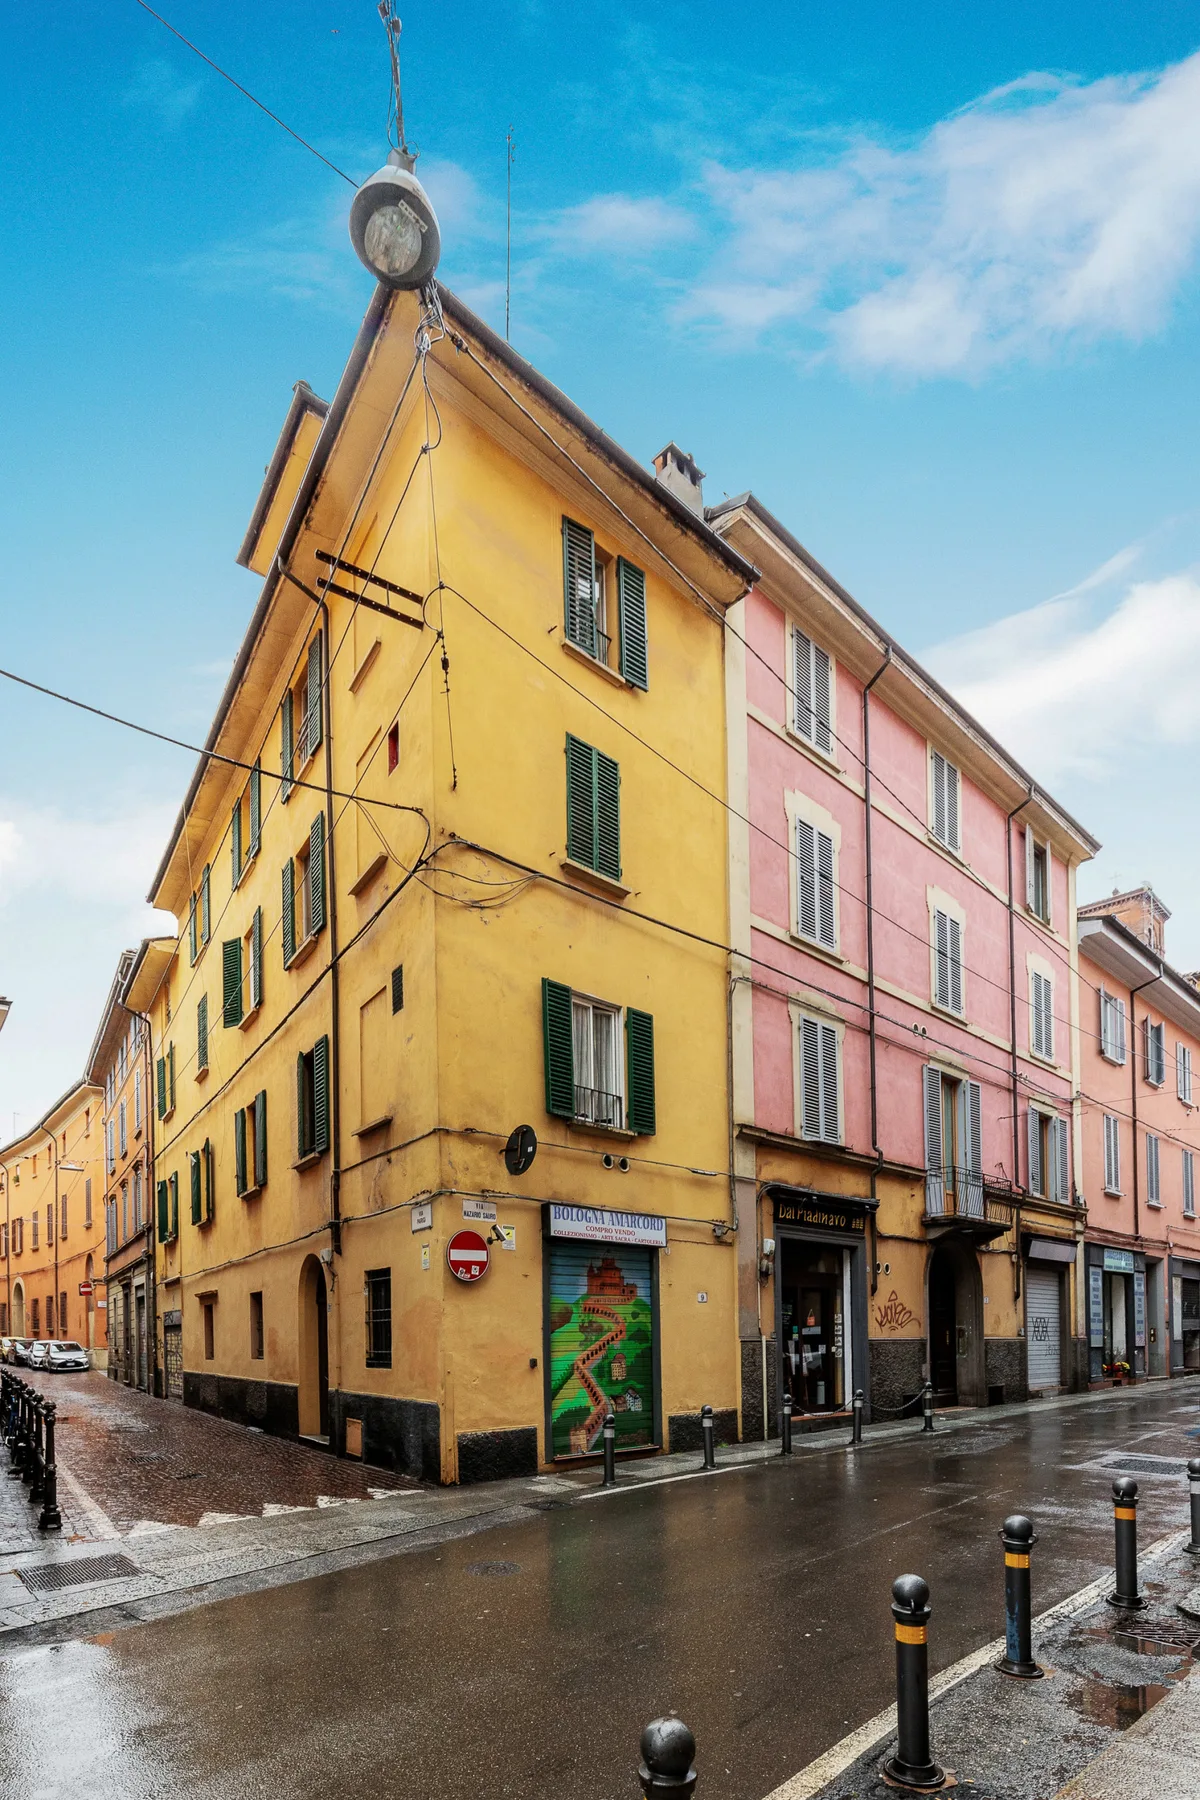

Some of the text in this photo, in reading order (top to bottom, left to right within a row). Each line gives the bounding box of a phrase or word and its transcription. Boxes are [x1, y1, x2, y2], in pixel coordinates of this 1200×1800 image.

[463, 1210, 496, 1220] NAZARIO SAURO
[553, 1205, 664, 1231] BOLOGNA AMARCORD
[779, 1203, 846, 1227] Dal Piadinaro
[553, 1229, 597, 1239] COLLEZIONISMO
[634, 1237, 664, 1245] CARTOLERIA
[585, 1225, 636, 1236] COMPRO VENDO
